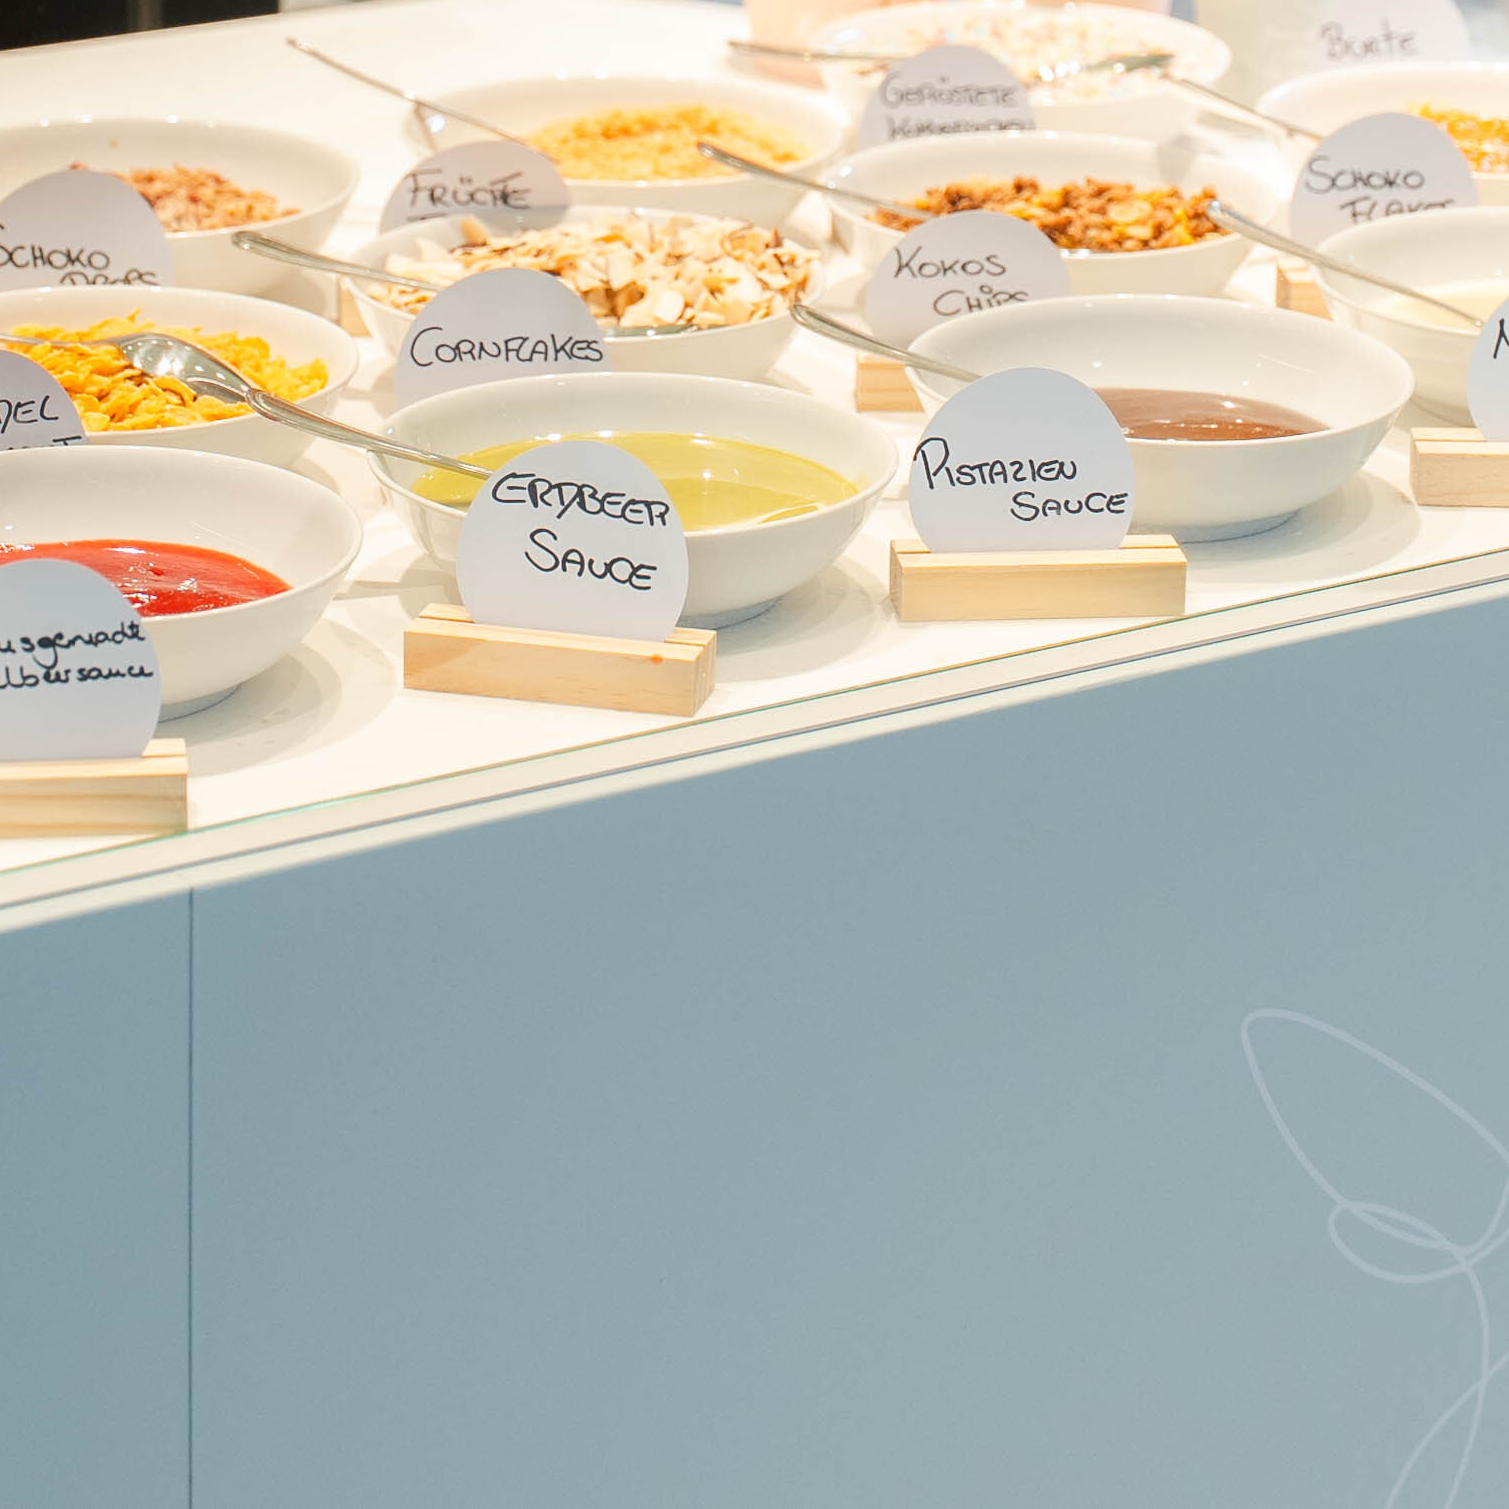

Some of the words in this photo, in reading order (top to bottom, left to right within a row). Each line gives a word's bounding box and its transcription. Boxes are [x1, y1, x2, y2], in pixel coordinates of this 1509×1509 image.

[893, 245, 1007, 279] KOKOS
[410, 326, 604, 367] CORNFLAKES
[492, 472, 670, 526] ERDBEER
[1010, 491, 1129, 522] SAUCE
[525, 528, 658, 590] SAUCE
